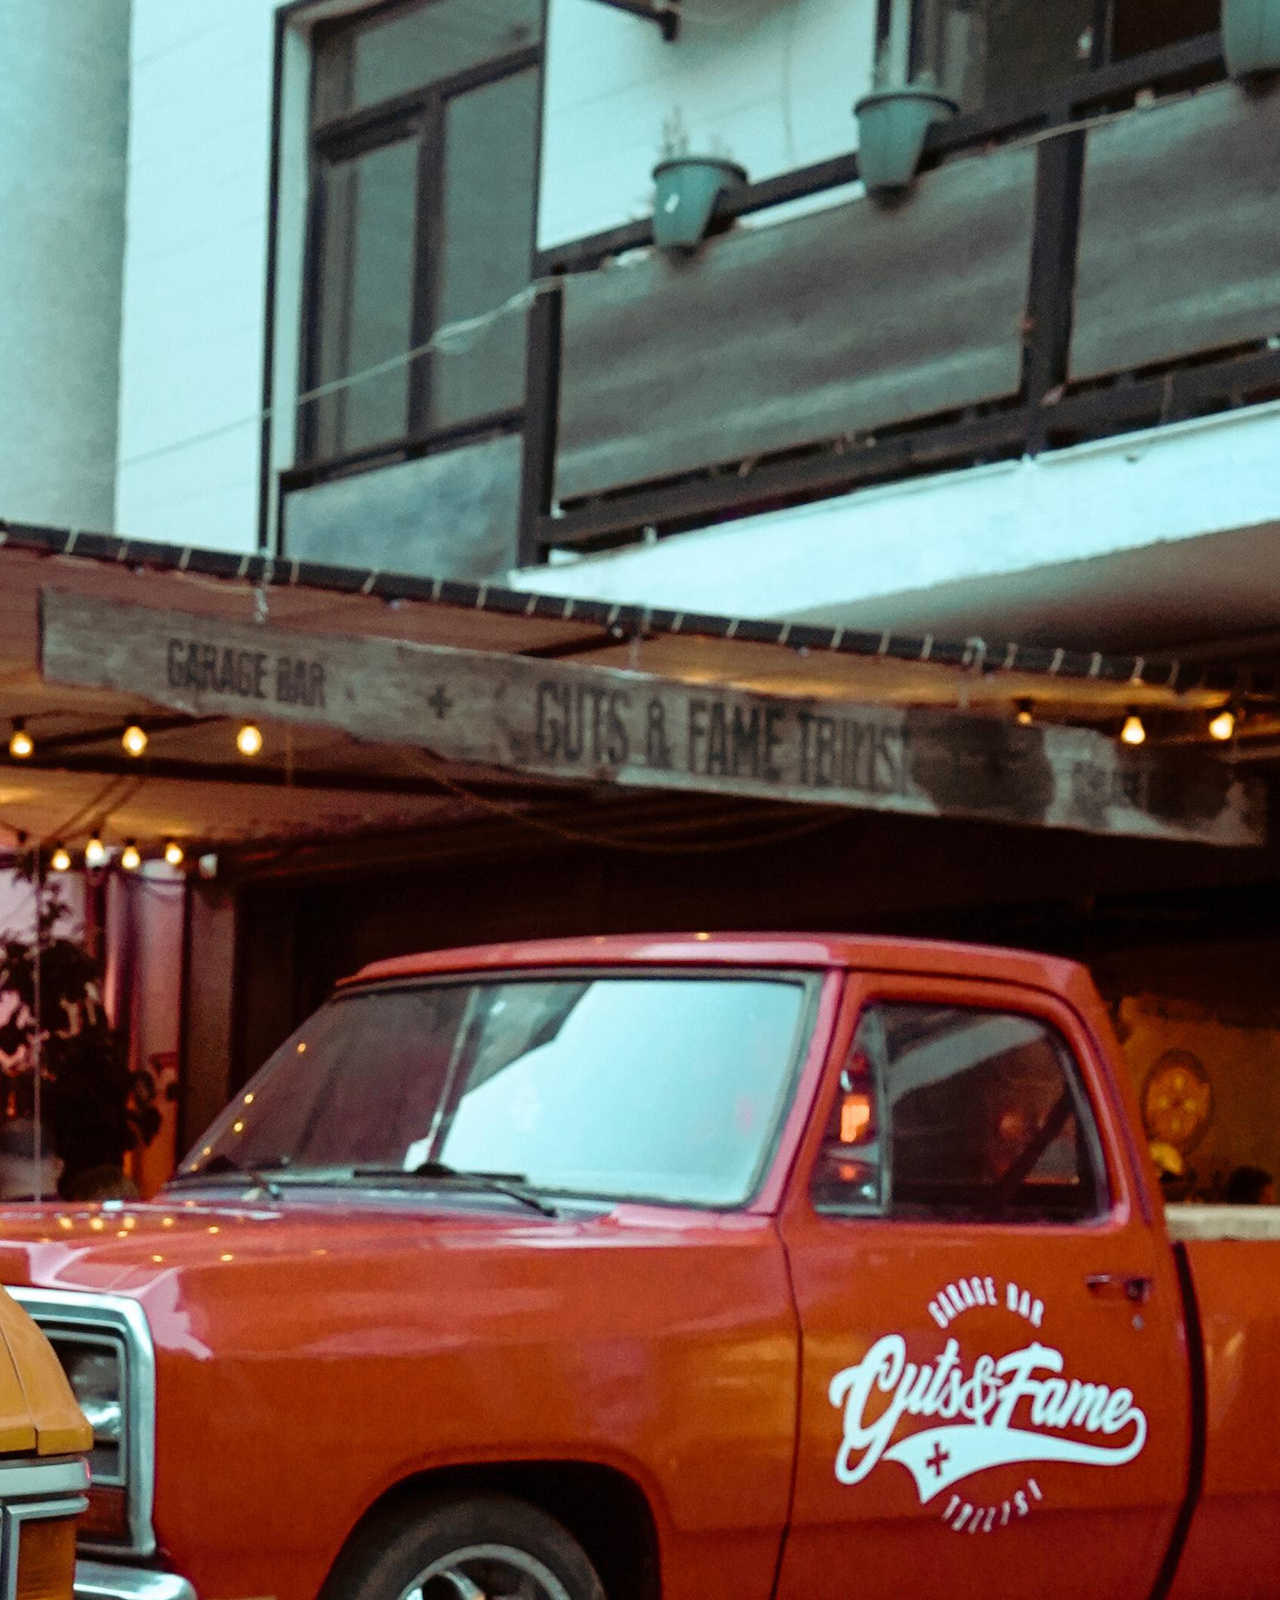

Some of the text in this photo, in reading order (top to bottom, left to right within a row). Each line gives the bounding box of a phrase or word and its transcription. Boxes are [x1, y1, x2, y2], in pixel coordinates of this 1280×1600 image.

[166, 638, 267, 699] GARAGE
[275, 649, 327, 707] BAR
[534, 680, 631, 766] GUTS
[645, 697, 672, 768] &
[688, 697, 783, 782] FAME
[927, 1275, 1045, 1329] GARAGE BAR
